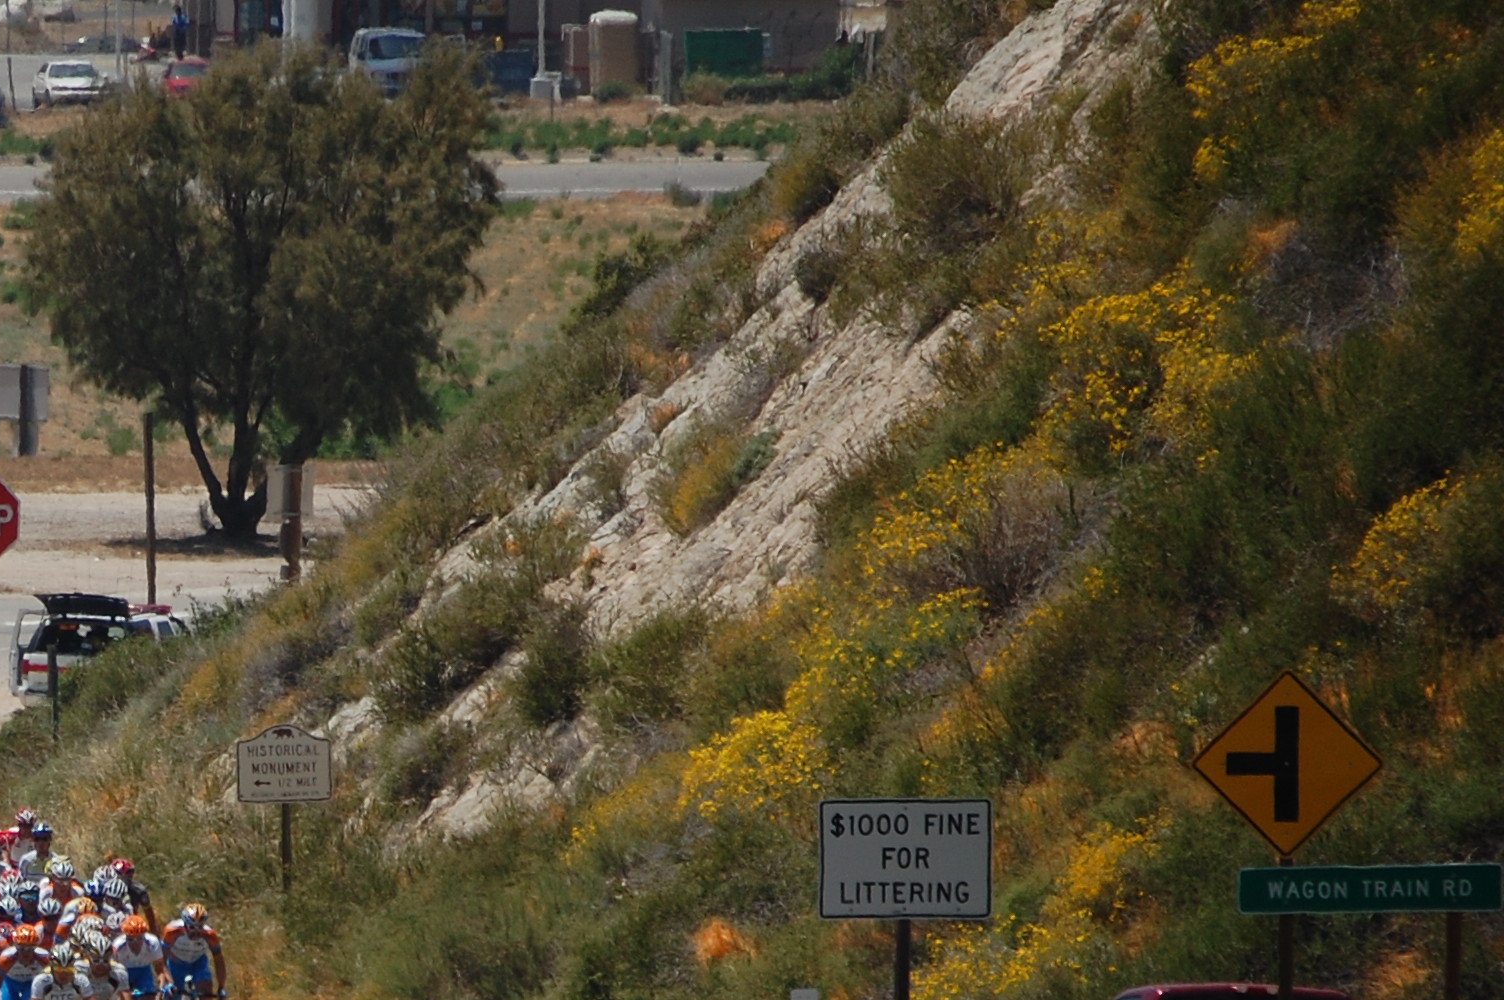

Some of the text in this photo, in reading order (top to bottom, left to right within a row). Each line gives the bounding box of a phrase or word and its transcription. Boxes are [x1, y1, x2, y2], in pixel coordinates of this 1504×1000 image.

[247, 744, 320, 757] HISTORICAL
[251, 761, 317, 775] MONUMENT
[278, 776, 317, 788] 1/2 MILE
[830, 812, 980, 838] $1000 FINE
[881, 847, 930, 870] FOR
[840, 881, 970, 904] LITTERING
[1267, 878, 1473, 899] WAGON TRAIN RD
